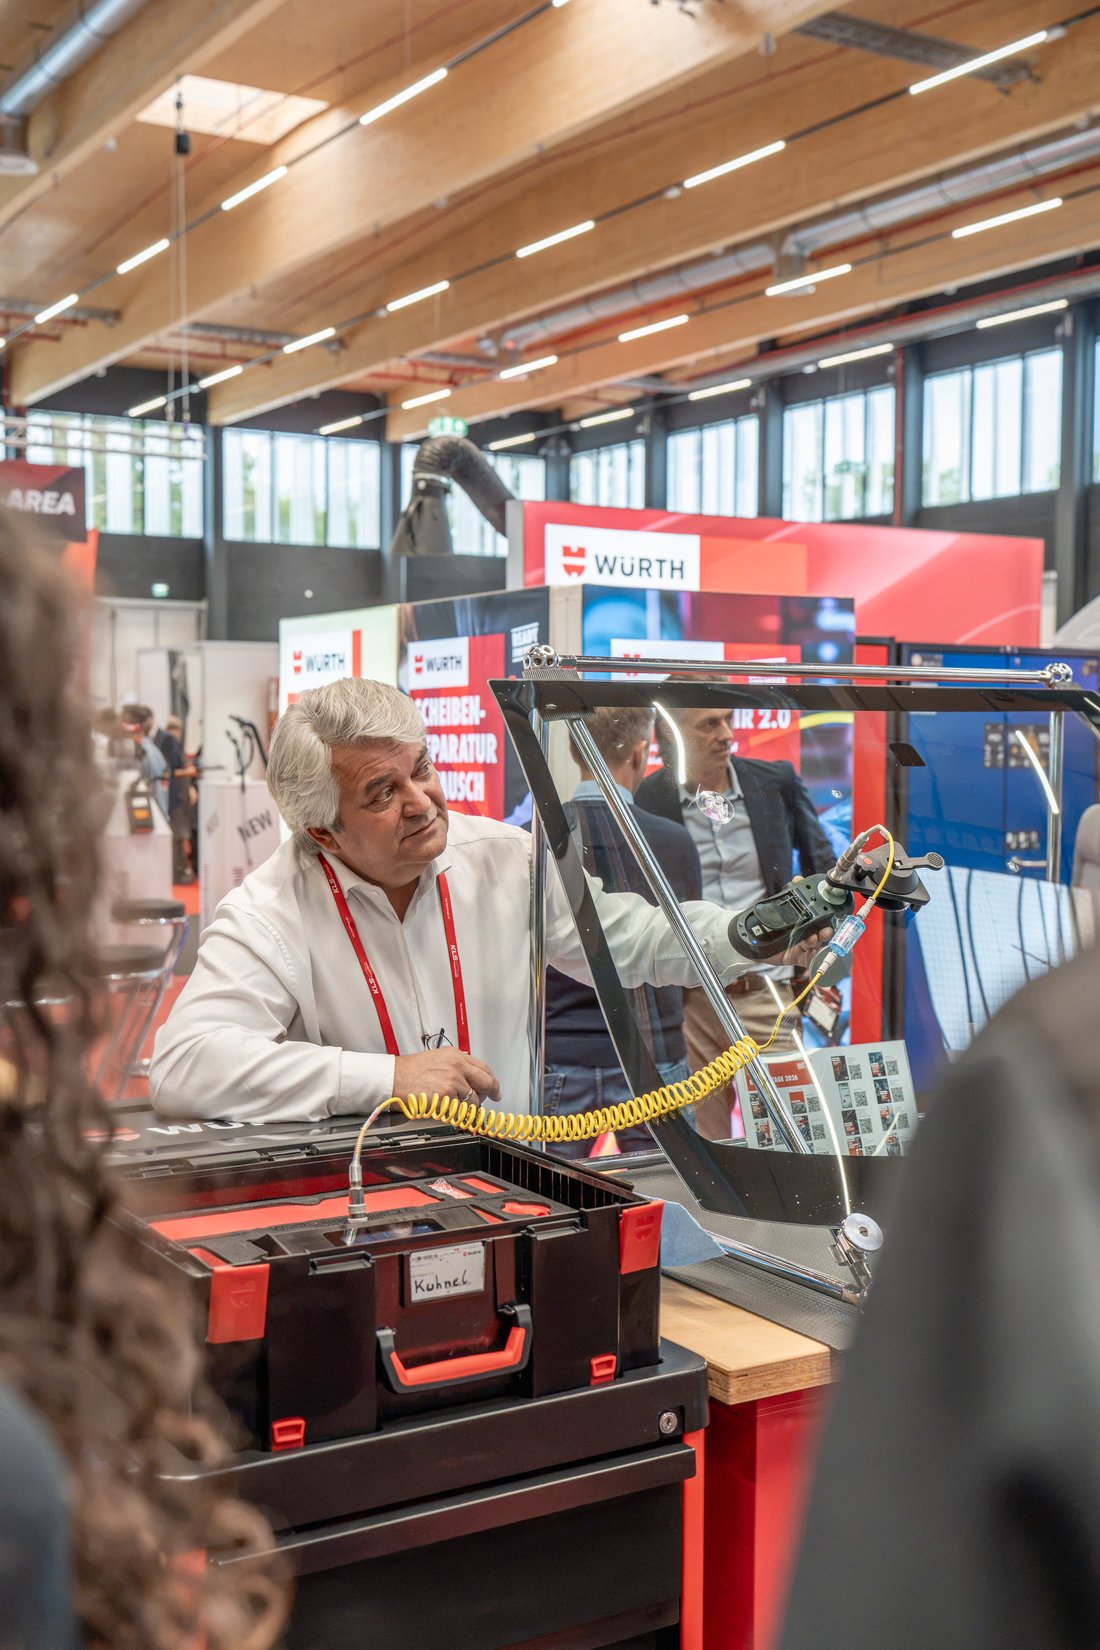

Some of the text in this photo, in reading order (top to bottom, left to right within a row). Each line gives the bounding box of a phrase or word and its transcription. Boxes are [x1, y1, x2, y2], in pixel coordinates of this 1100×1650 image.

[6, 488, 76, 516] AREA
[595, 554, 684, 580] WÜRTH
[732, 709, 792, 730] IR 2.0
[437, 770, 485, 802] AUSCH
[237, 810, 273, 841] NEW
[450, 944, 459, 961] KLS
[367, 977, 379, 995] KLS
